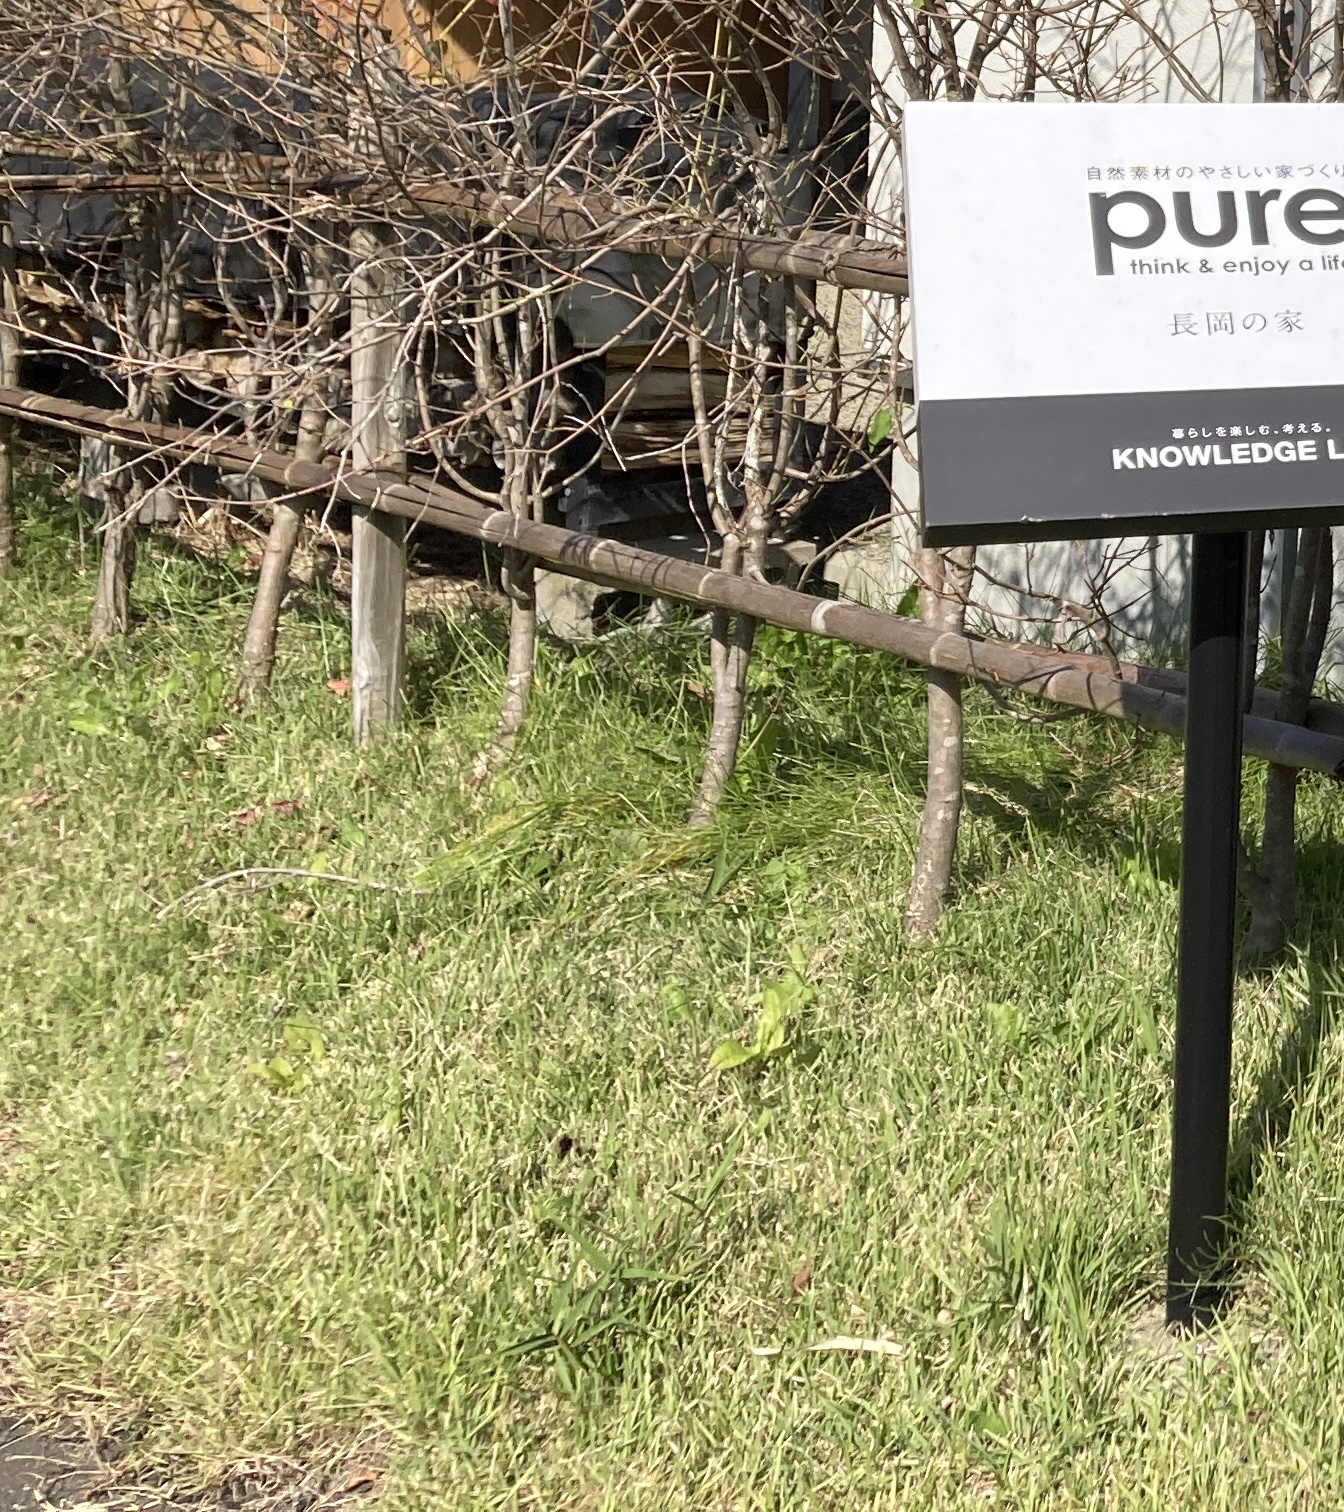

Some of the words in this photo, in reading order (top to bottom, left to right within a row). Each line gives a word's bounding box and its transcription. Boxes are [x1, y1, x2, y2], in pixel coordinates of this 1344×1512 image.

[1130, 258, 1191, 275] think
[1199, 259, 1214, 273] &
[1222, 257, 1291, 277] enjoy
[1298, 259, 1314, 271] a
[1170, 309, 1305, 337] 長岡の家
[1171, 422, 1332, 439] 暮らしを楽しむ、考える。
[1112, 440, 1318, 470] KNOWLEDGE
